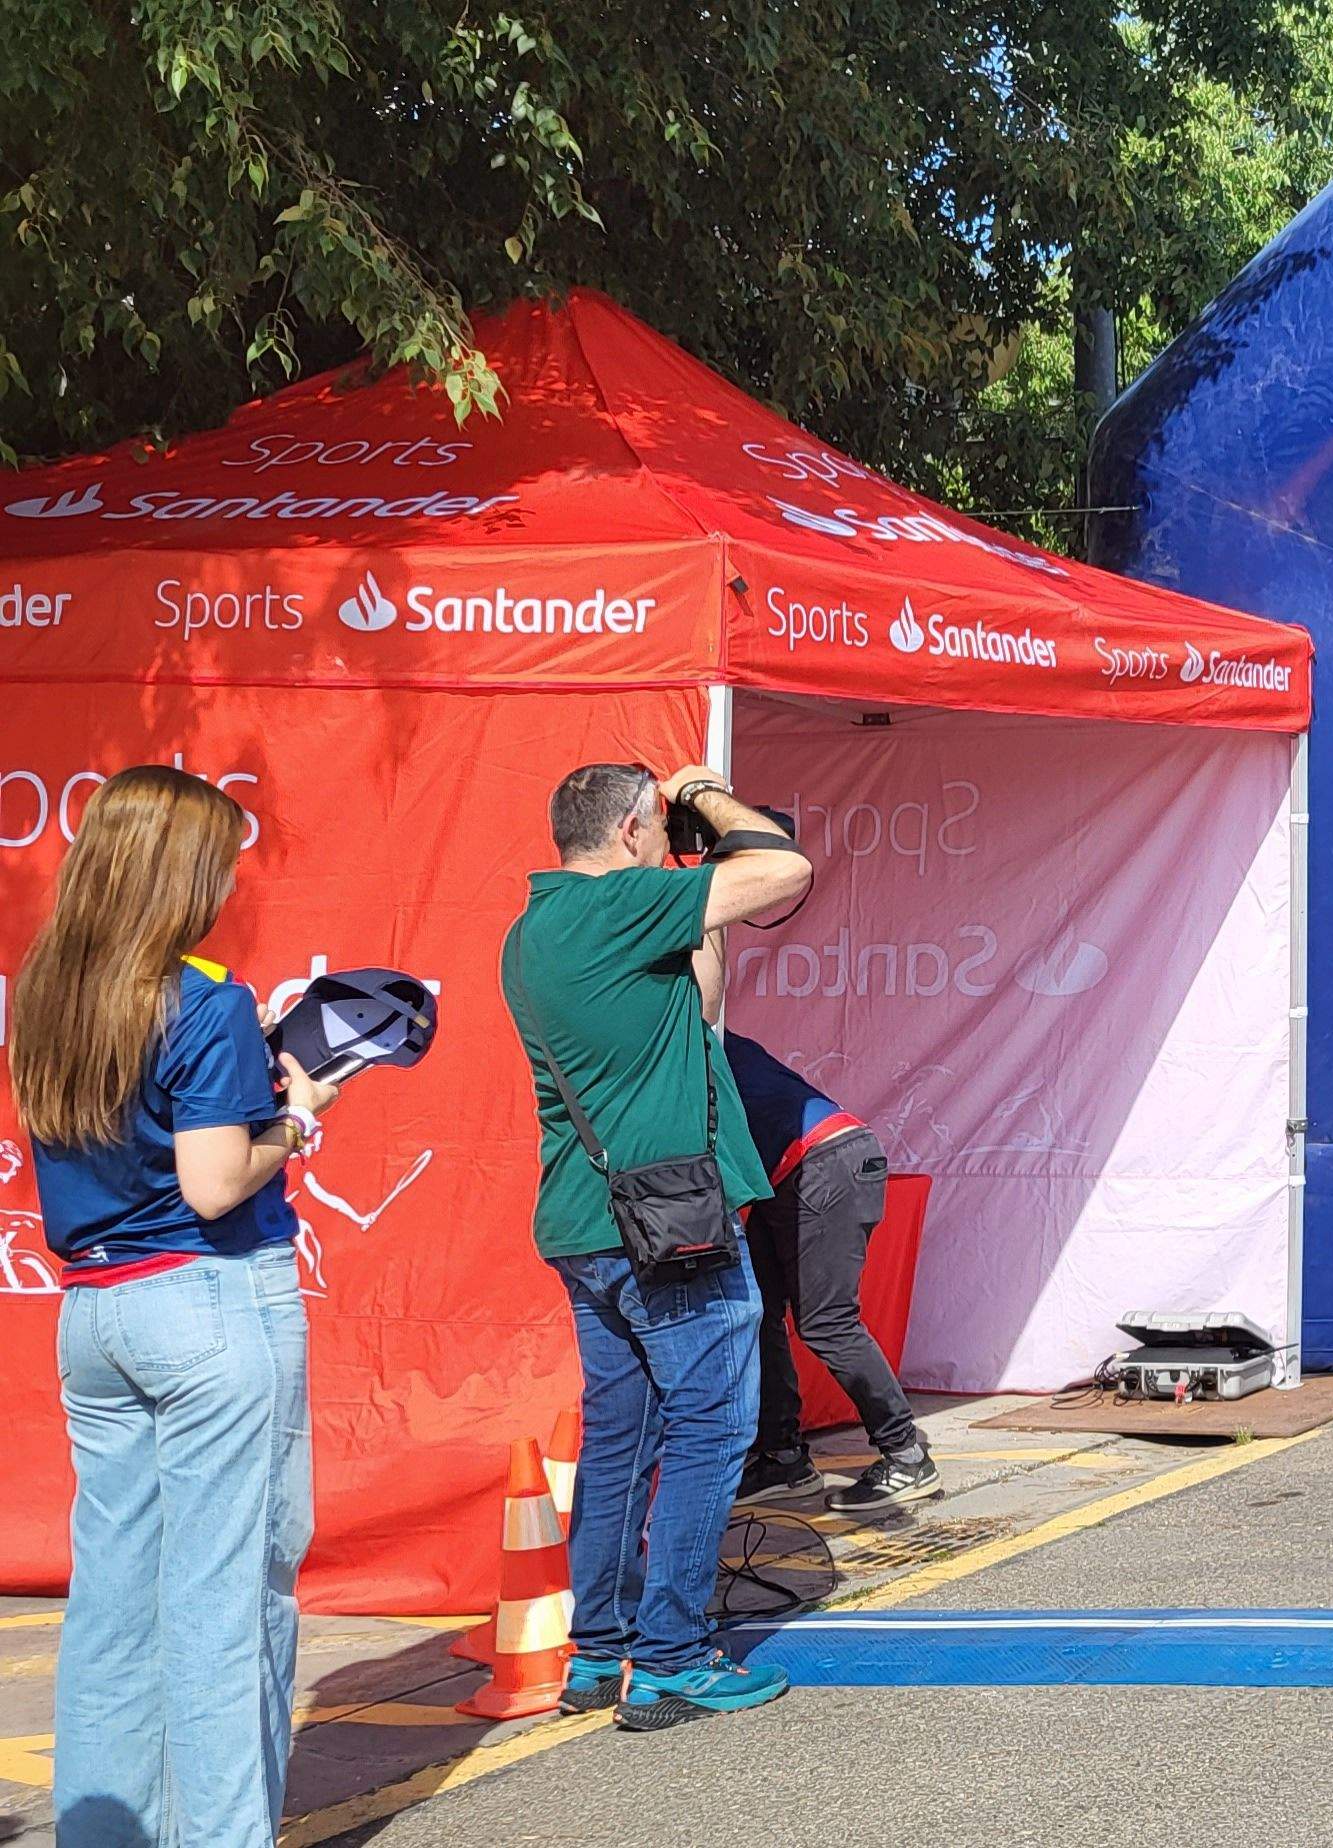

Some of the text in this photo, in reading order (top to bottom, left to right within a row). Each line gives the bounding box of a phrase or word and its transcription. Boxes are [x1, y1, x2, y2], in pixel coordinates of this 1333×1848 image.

[221, 433, 473, 474] Sports
[103, 490, 520, 520] Santander
[154, 579, 304, 640] Sports
[405, 586, 656, 636] Santander
[766, 586, 1057, 668] Sports Santander
[1093, 638, 1291, 693] Sports Santander
